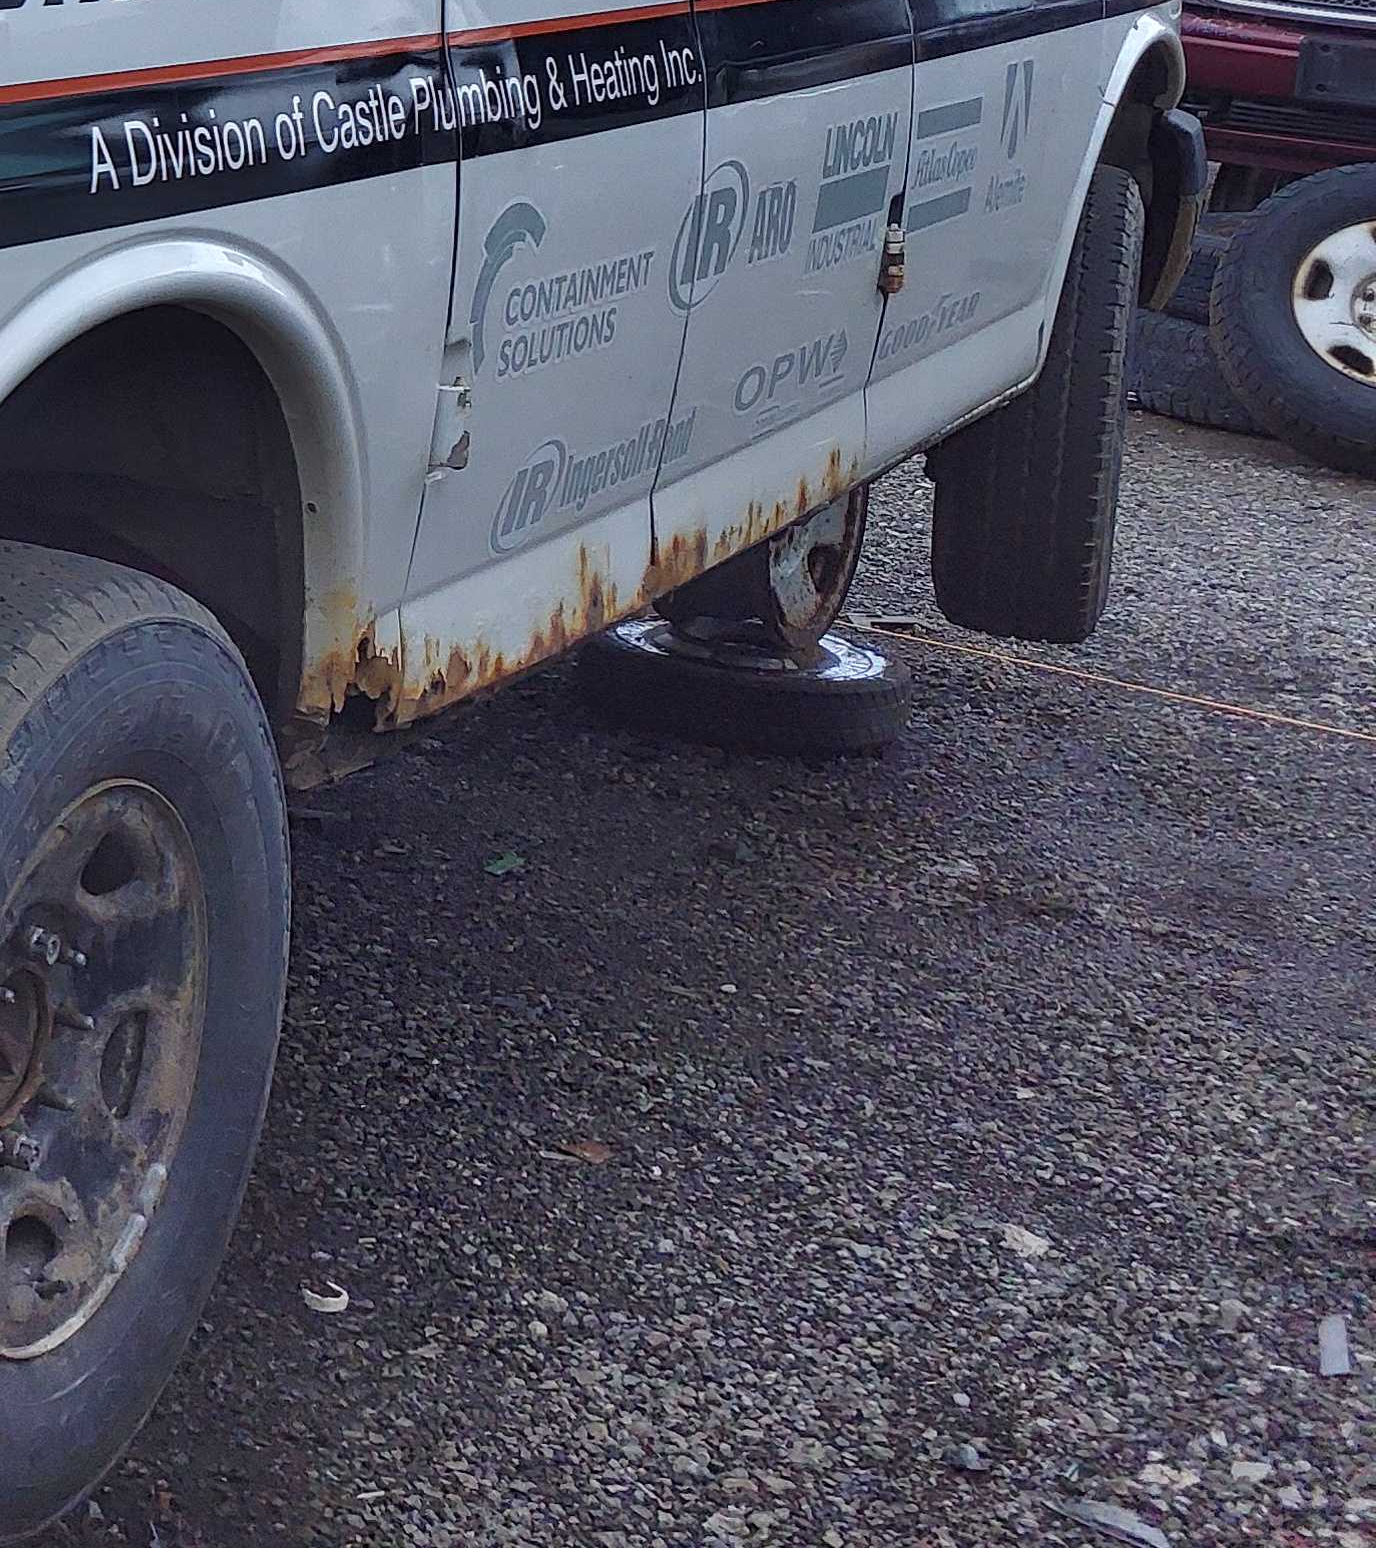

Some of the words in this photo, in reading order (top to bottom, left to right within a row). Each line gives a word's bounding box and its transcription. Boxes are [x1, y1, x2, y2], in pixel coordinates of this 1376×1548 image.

[89, 126, 119, 194] A
[125, 116, 267, 187] Division
[275, 95, 307, 161] of
[313, 83, 405, 149] Castle
[412, 63, 542, 132] Plumbing
[548, 57, 568, 110] &
[573, 49, 659, 108] Heating
[662, 40, 703, 89] Inc.
[823, 112, 897, 179] LINCOLN
[748, 181, 796, 264] ARO
[506, 251, 655, 326] CONTAINMENT
[498, 307, 617, 376] SOLUTIONS
[735, 333, 835, 411] OPW
